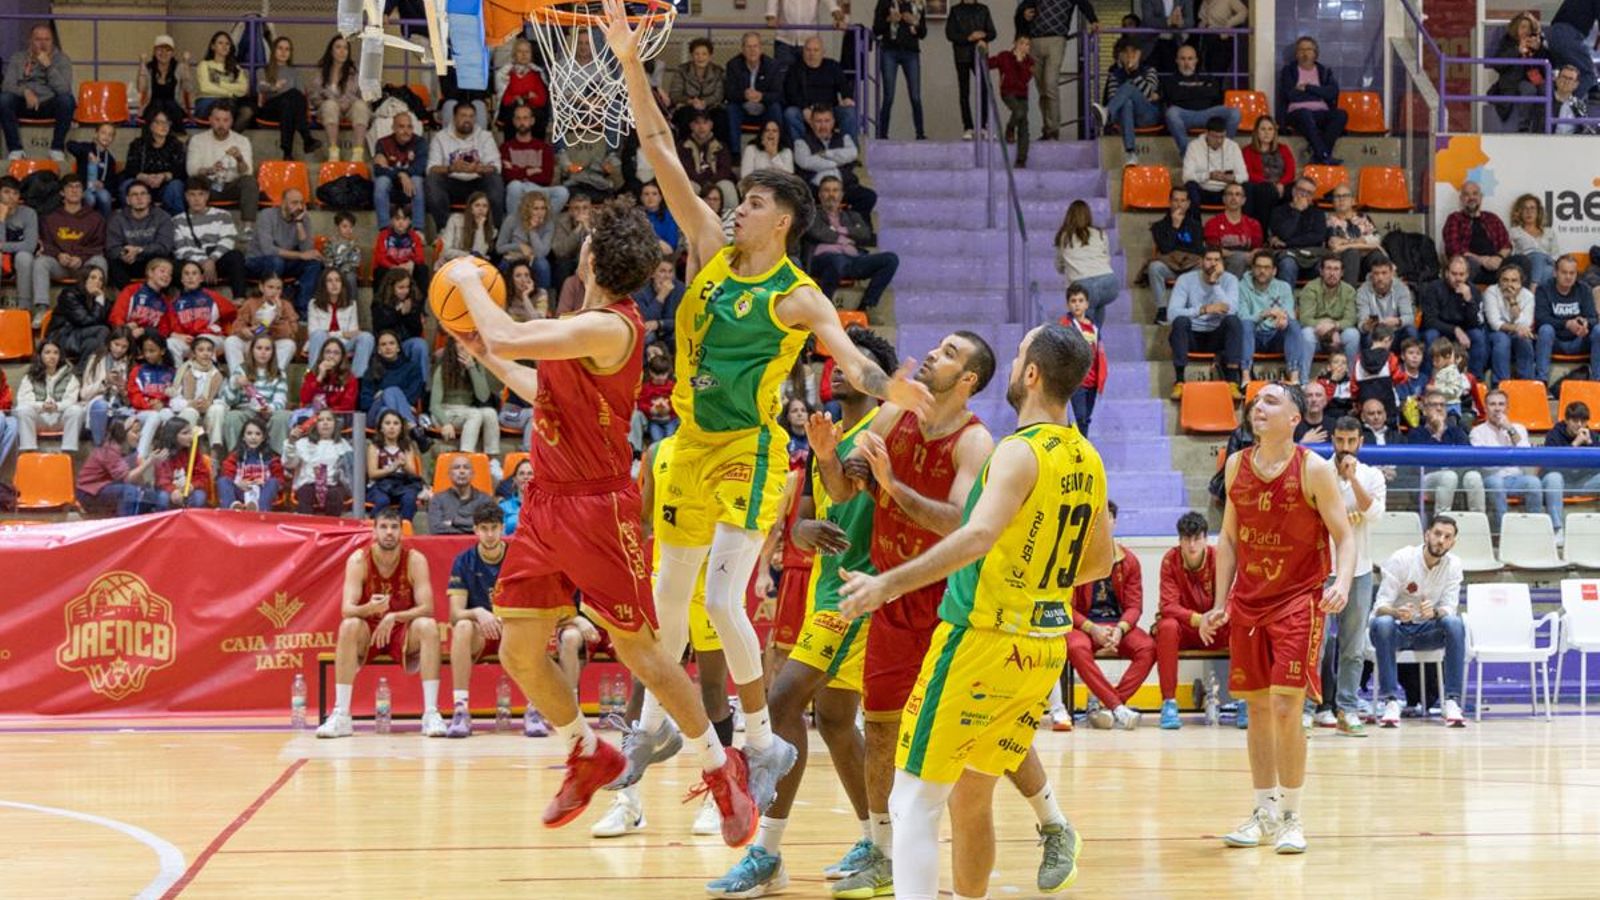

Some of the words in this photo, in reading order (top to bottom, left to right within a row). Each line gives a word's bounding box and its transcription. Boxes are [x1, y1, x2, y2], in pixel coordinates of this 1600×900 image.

[1552, 301, 1580, 315] VANS
[1258, 491, 1273, 512] 16
[1020, 510, 1045, 564] RUSTER
[1037, 503, 1093, 590] 13
[221, 634, 267, 653] CAJA
[275, 631, 337, 650] RURAL
[256, 650, 304, 671] JAÉN
[1288, 660, 1302, 675] 16
